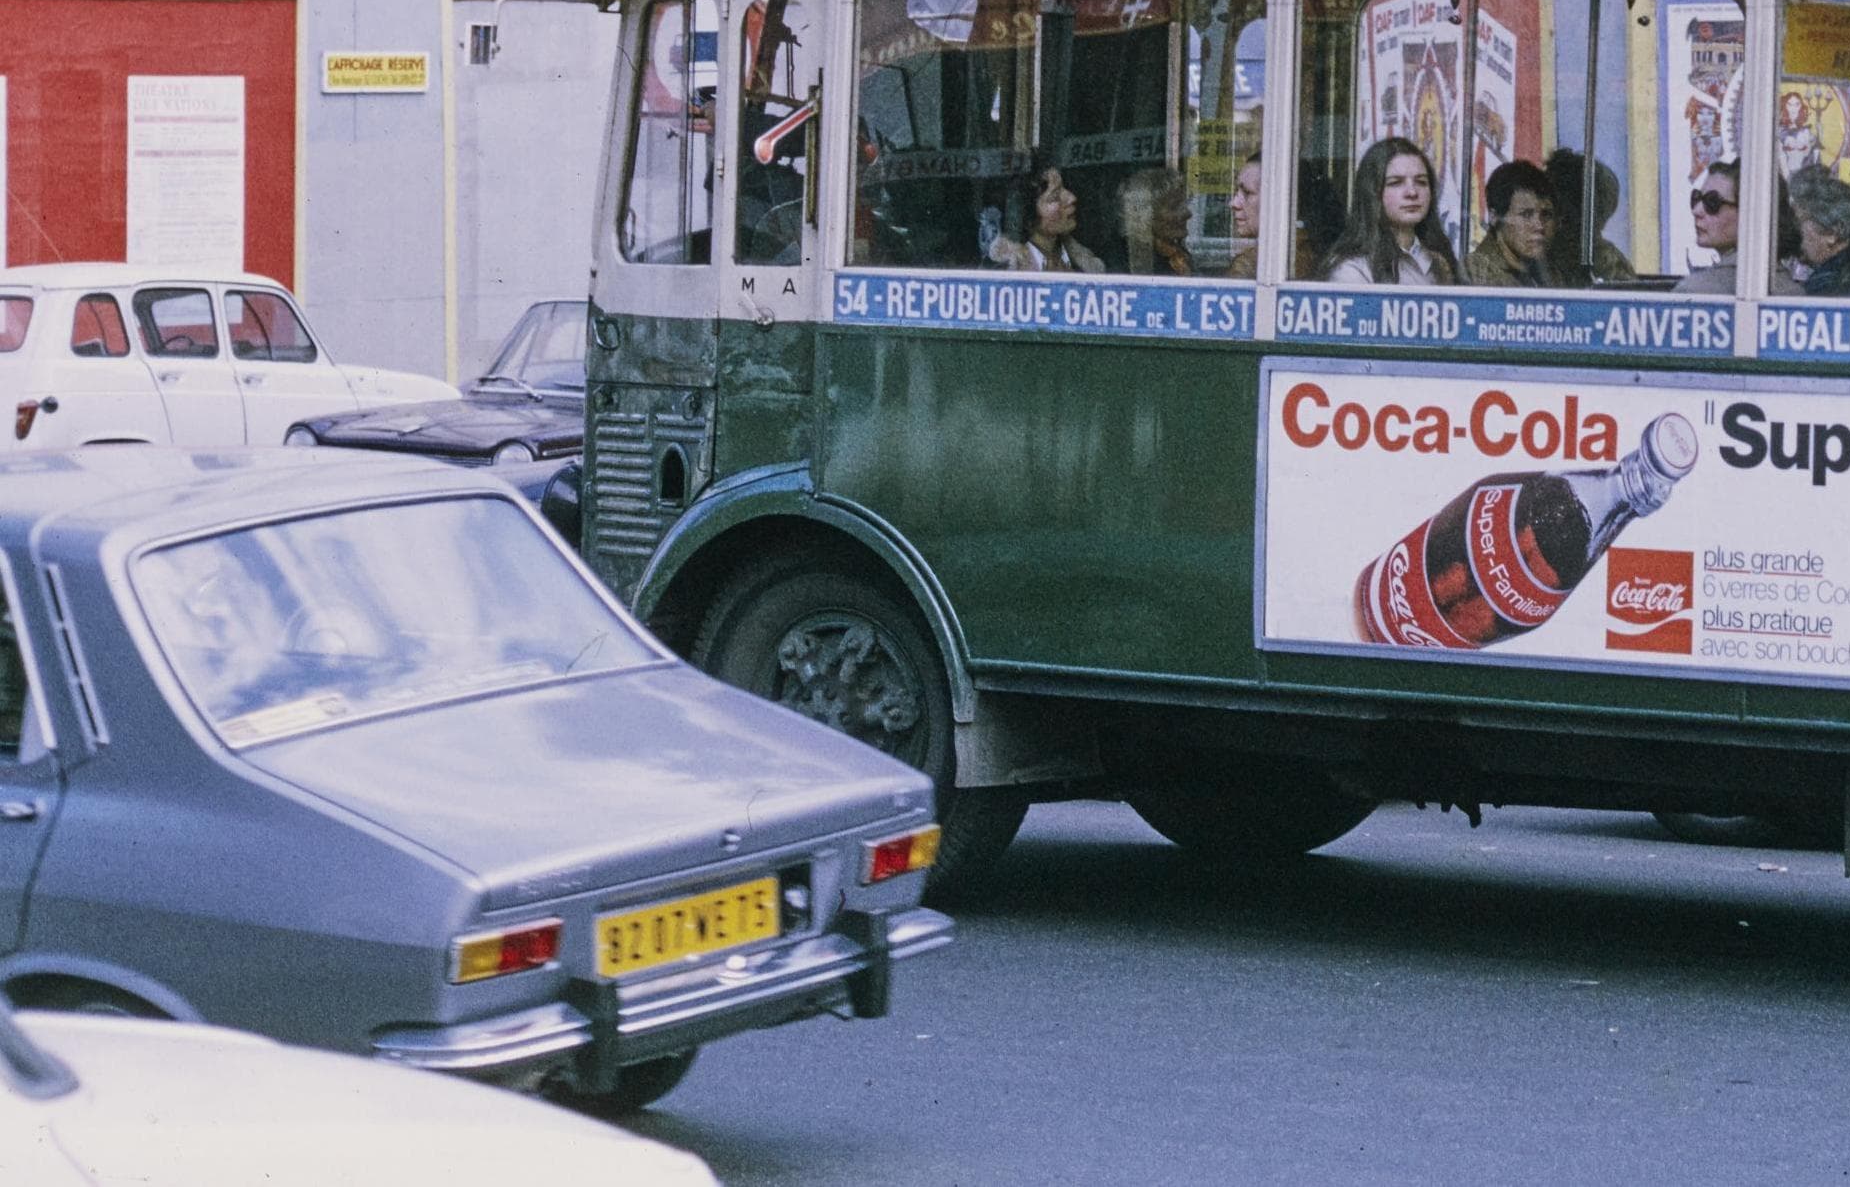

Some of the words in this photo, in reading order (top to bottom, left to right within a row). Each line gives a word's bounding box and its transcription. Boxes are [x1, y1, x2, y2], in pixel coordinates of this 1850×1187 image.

[742, 278, 755, 294] M
[782, 279, 797, 295] A
[837, 278, 868, 315] 54
[1065, 288, 1137, 327] GARE
[1146, 311, 1165, 328] DE
[1175, 292, 1254, 333] L'EST
[1277, 296, 1353, 336] GARE
[1358, 319, 1378, 337] DU
[1381, 299, 1459, 340] NORD
[1478, 323, 1592, 345] ROCHECHOUART
[1603, 307, 1731, 349] ANVERS
[1282, 382, 1618, 462] Coca-Cola
[1704, 546, 1744, 572] plus
[1751, 550, 1824, 574] grande
[1612, 579, 1686, 612] Coca-Cola
[1703, 575, 1716, 597] 6
[1719, 580, 1778, 600] verres
[1784, 579, 1810, 602] de
[1703, 608, 1743, 632] plus
[1750, 610, 1833, 636] pratique
[1701, 638, 1748, 658] avec
[1755, 641, 1791, 662] son
